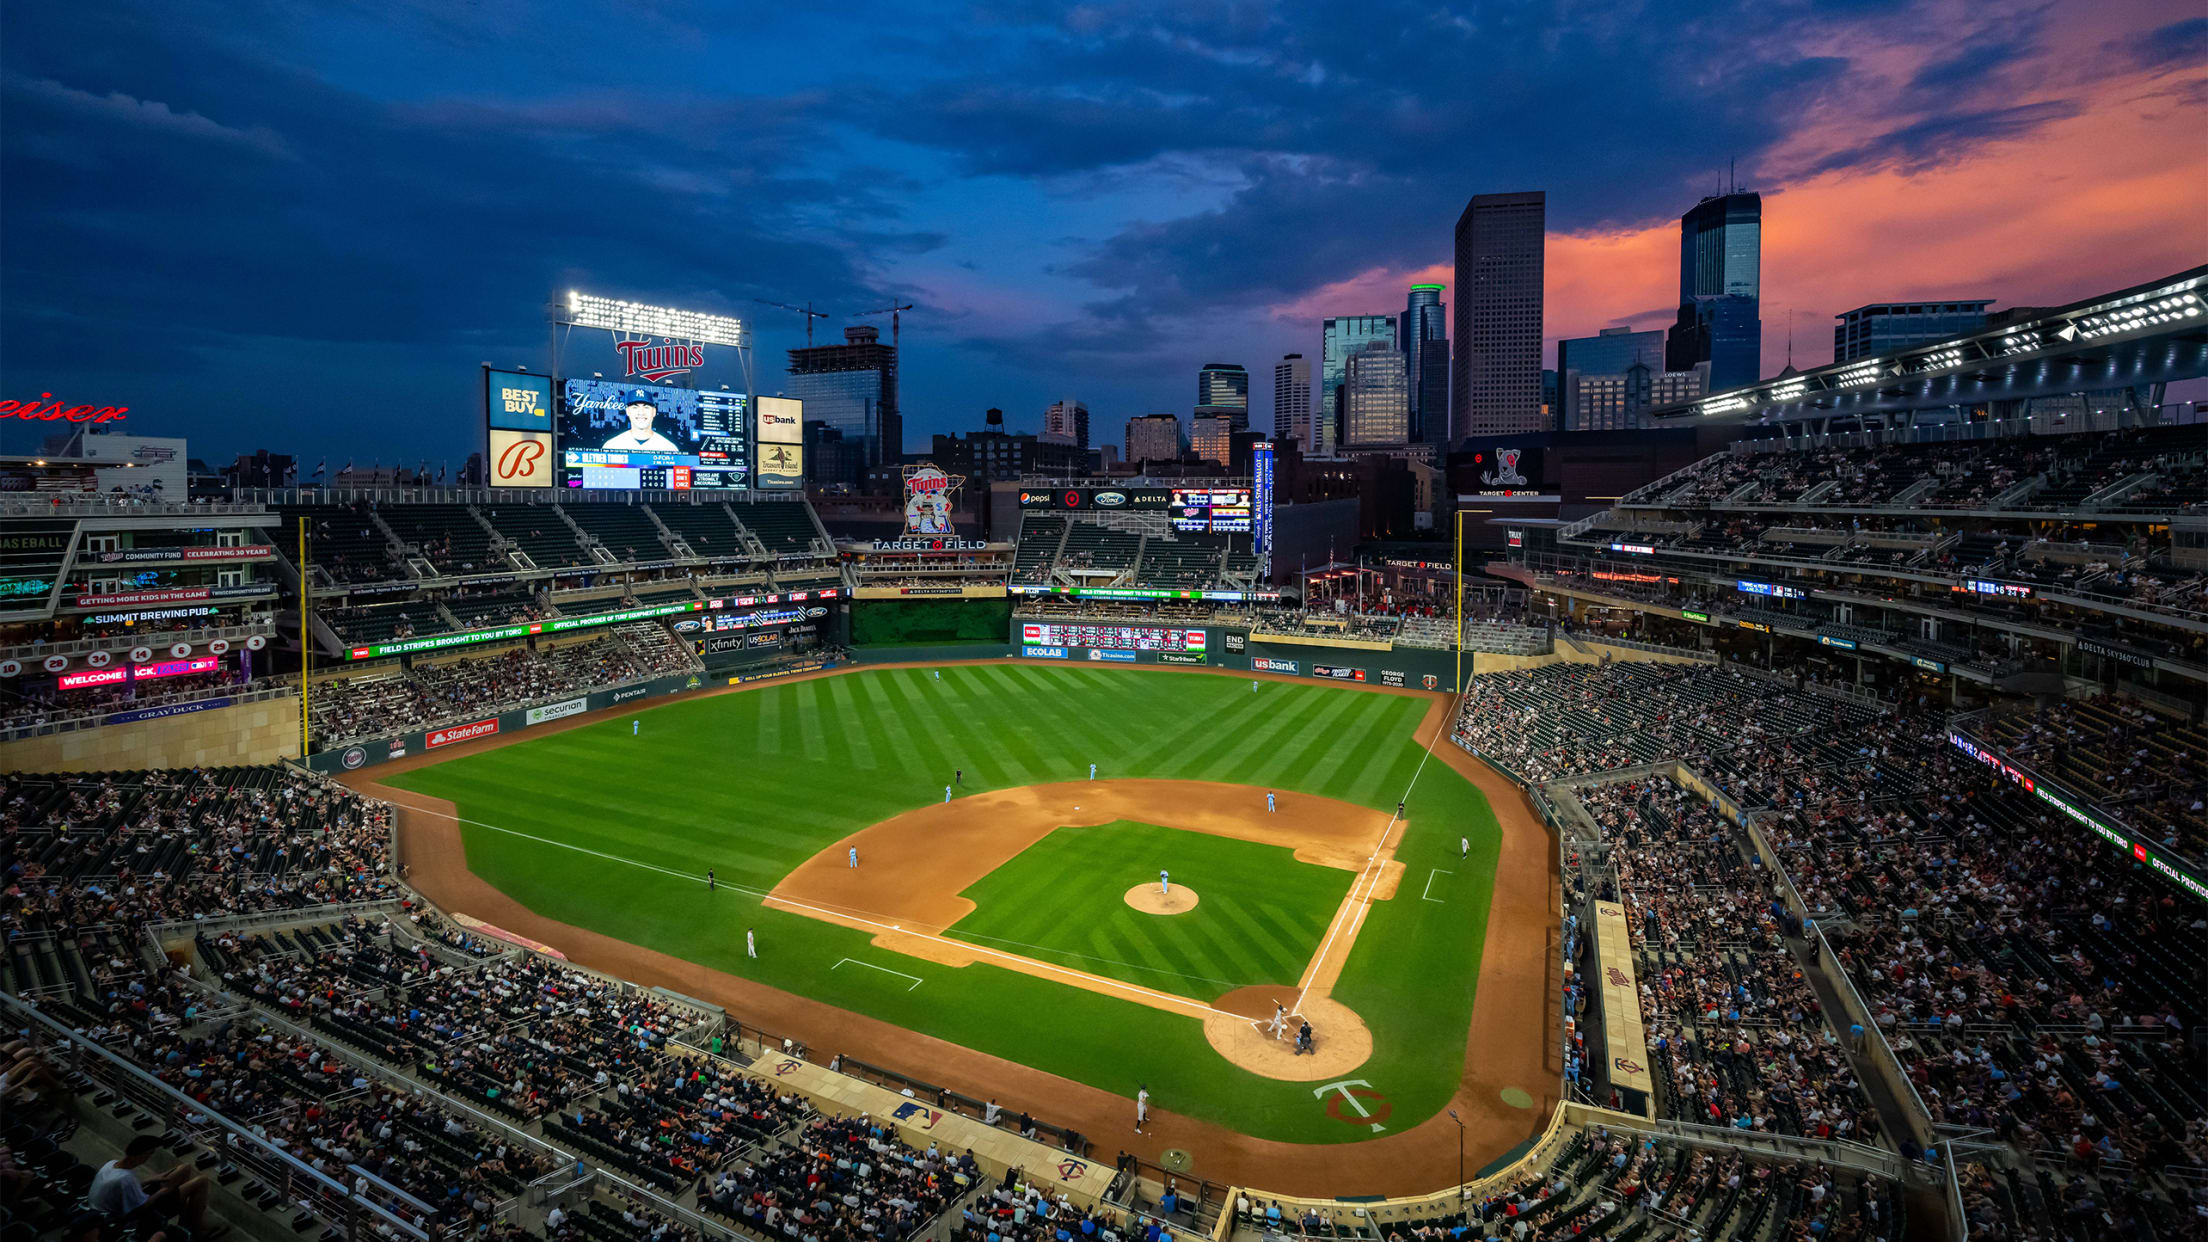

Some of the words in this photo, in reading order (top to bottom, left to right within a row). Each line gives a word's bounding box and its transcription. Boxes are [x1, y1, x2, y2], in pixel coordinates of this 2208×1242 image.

[616, 337, 704, 377] Twins
[502, 388, 539, 403] BEST
[505, 400, 536, 414] BUY
[498, 440, 545, 479] B
[907, 476, 948, 495] Twins
[1031, 494, 1050, 502] pepsi
[872, 542, 931, 550] TARGET
[945, 541, 986, 549] FIELD
[125, 552, 163, 560] COMMUNITY
[95, 612, 139, 624] SUMMIT
[140, 609, 188, 620] BREWING
[189, 607, 209, 616] PUB
[379, 646, 401, 654] FIELD
[403, 641, 435, 651] STRIPES
[436, 636, 469, 646] BROUGHT
[554, 621, 579, 629] OFFICIAL
[213, 643, 226, 651] 29
[710, 639, 742, 651] xfinity
[1027, 648, 1062, 656] ECOLAB
[93, 655, 106, 663] 34
[136, 650, 147, 659] 14
[2084, 642, 2105, 655] DELTA
[2133, 656, 2150, 668] CLUB
[4, 664, 15, 672] 10
[50, 659, 63, 667] 28
[64, 672, 122, 686] WELCOME
[621, 688, 646, 698] PENTAIR
[138, 709, 170, 719] GRAY
[173, 704, 204, 714] DUCK
[544, 701, 582, 715] securian
[447, 727, 471, 741] State
[471, 722, 494, 734] Farm
[2066, 806, 2088, 824] BROUGHT
[2095, 823, 2106, 835] YOU
[2106, 829, 2113, 839] BY
[2113, 834, 2128, 848] TORO
[2152, 857, 2180, 881] OFFICIAL
